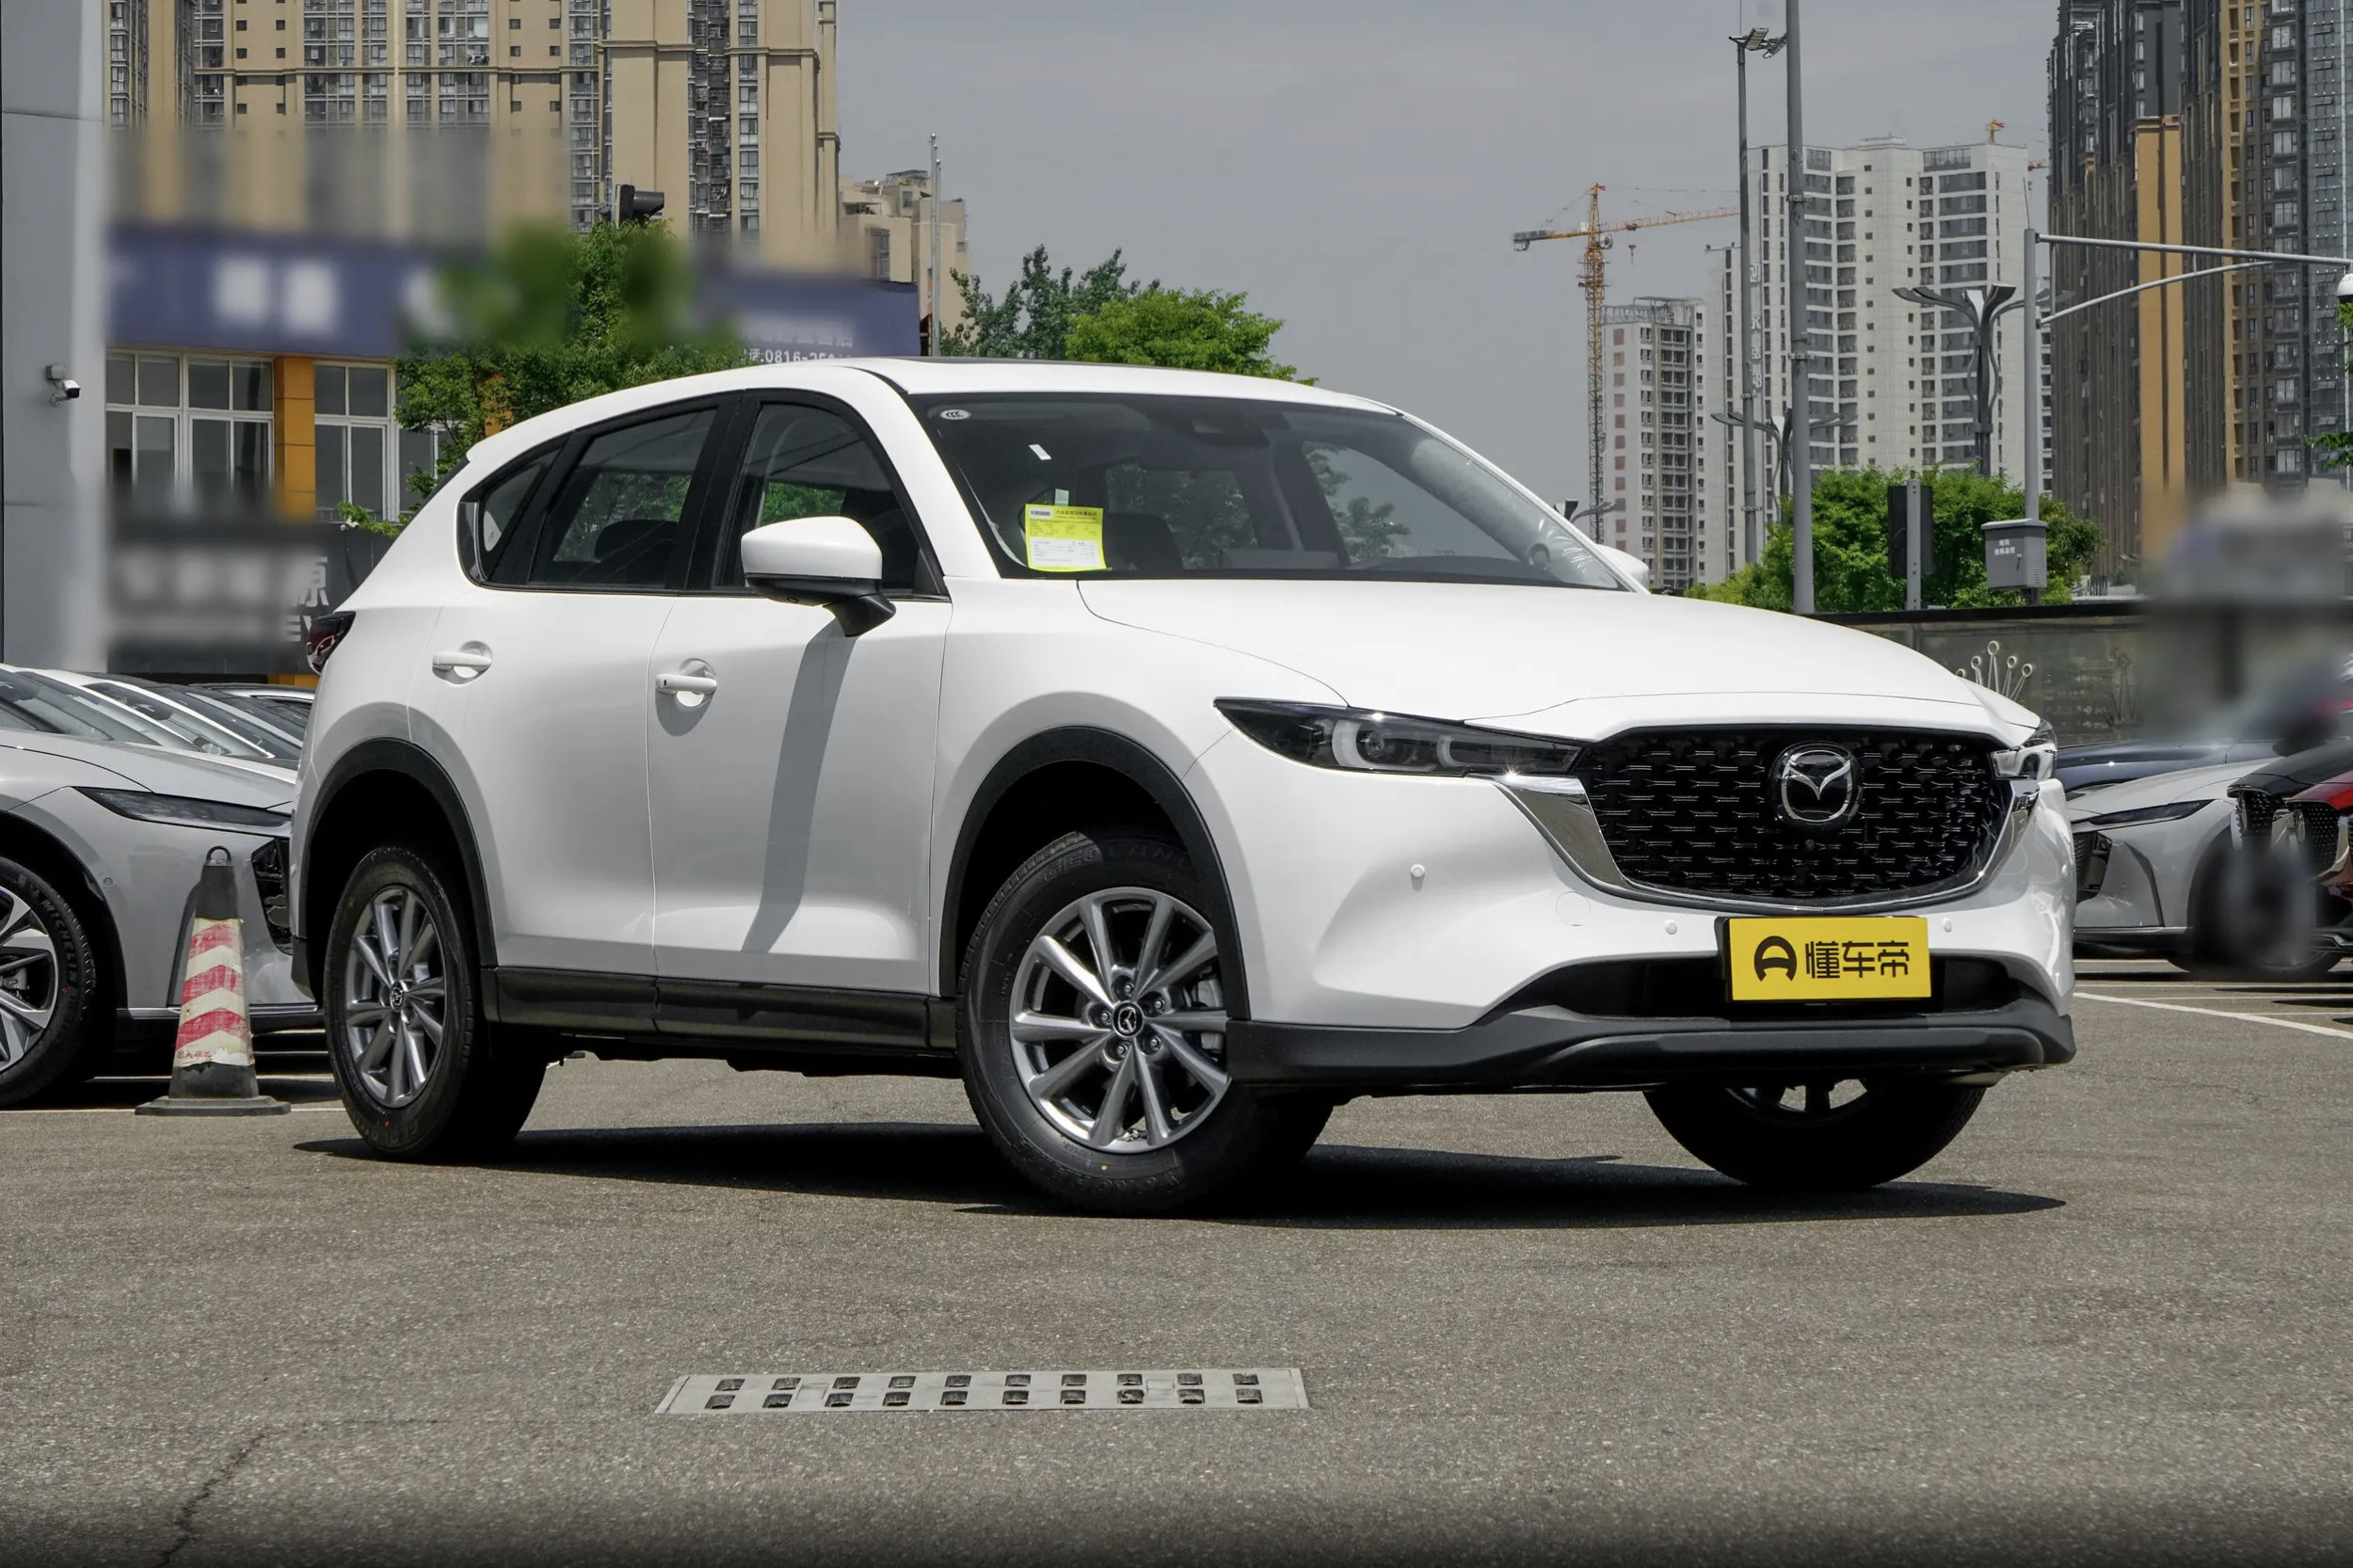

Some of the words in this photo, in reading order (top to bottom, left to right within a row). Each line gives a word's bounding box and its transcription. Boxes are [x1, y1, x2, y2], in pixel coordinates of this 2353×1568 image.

[40, 897, 79, 987] MICHELIN
[1805, 940, 1910, 979] 懂车帝
